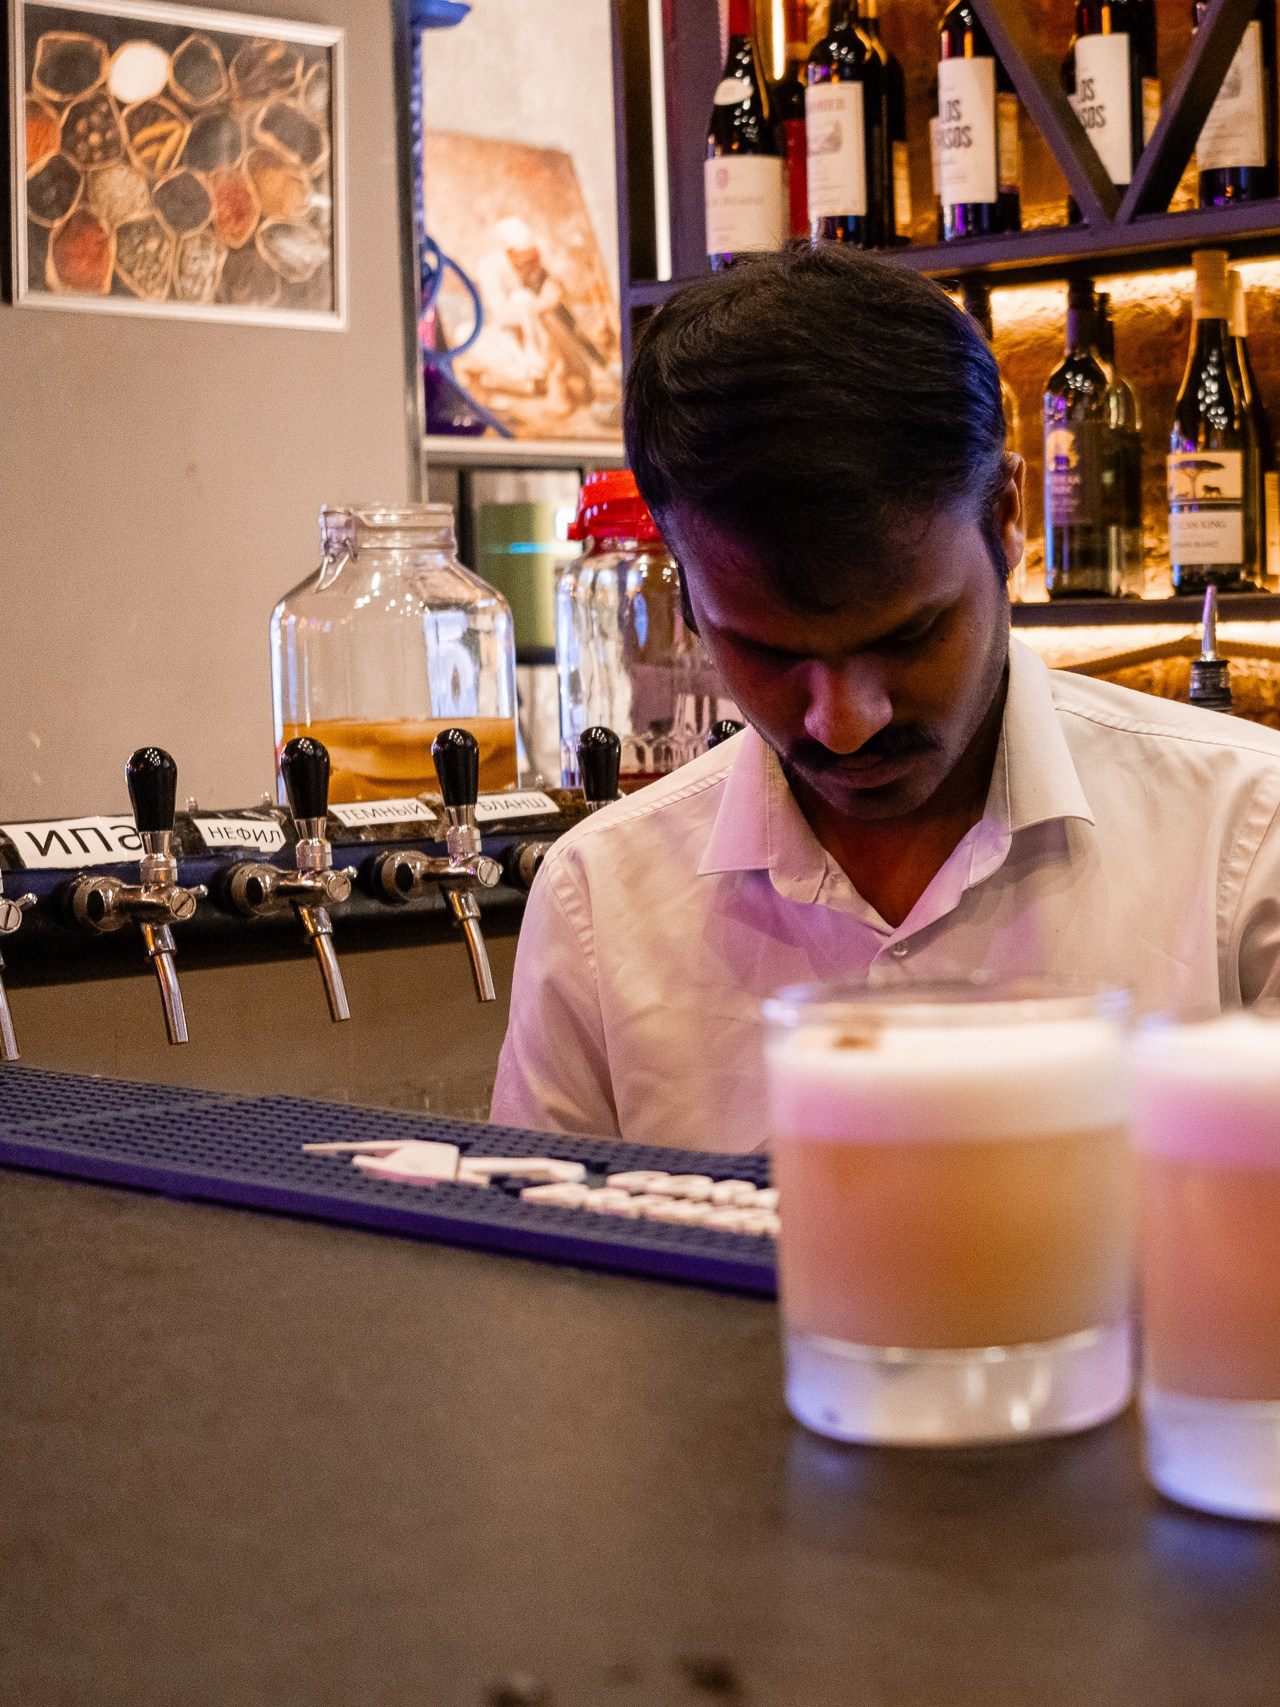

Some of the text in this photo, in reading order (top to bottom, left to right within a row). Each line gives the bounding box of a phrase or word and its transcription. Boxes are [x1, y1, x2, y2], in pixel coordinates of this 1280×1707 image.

[337, 802, 428, 822] ТЕМНЫЙ
[479, 796, 548, 812] БЛАНШ
[207, 825, 282, 845] НЕФИЛ
